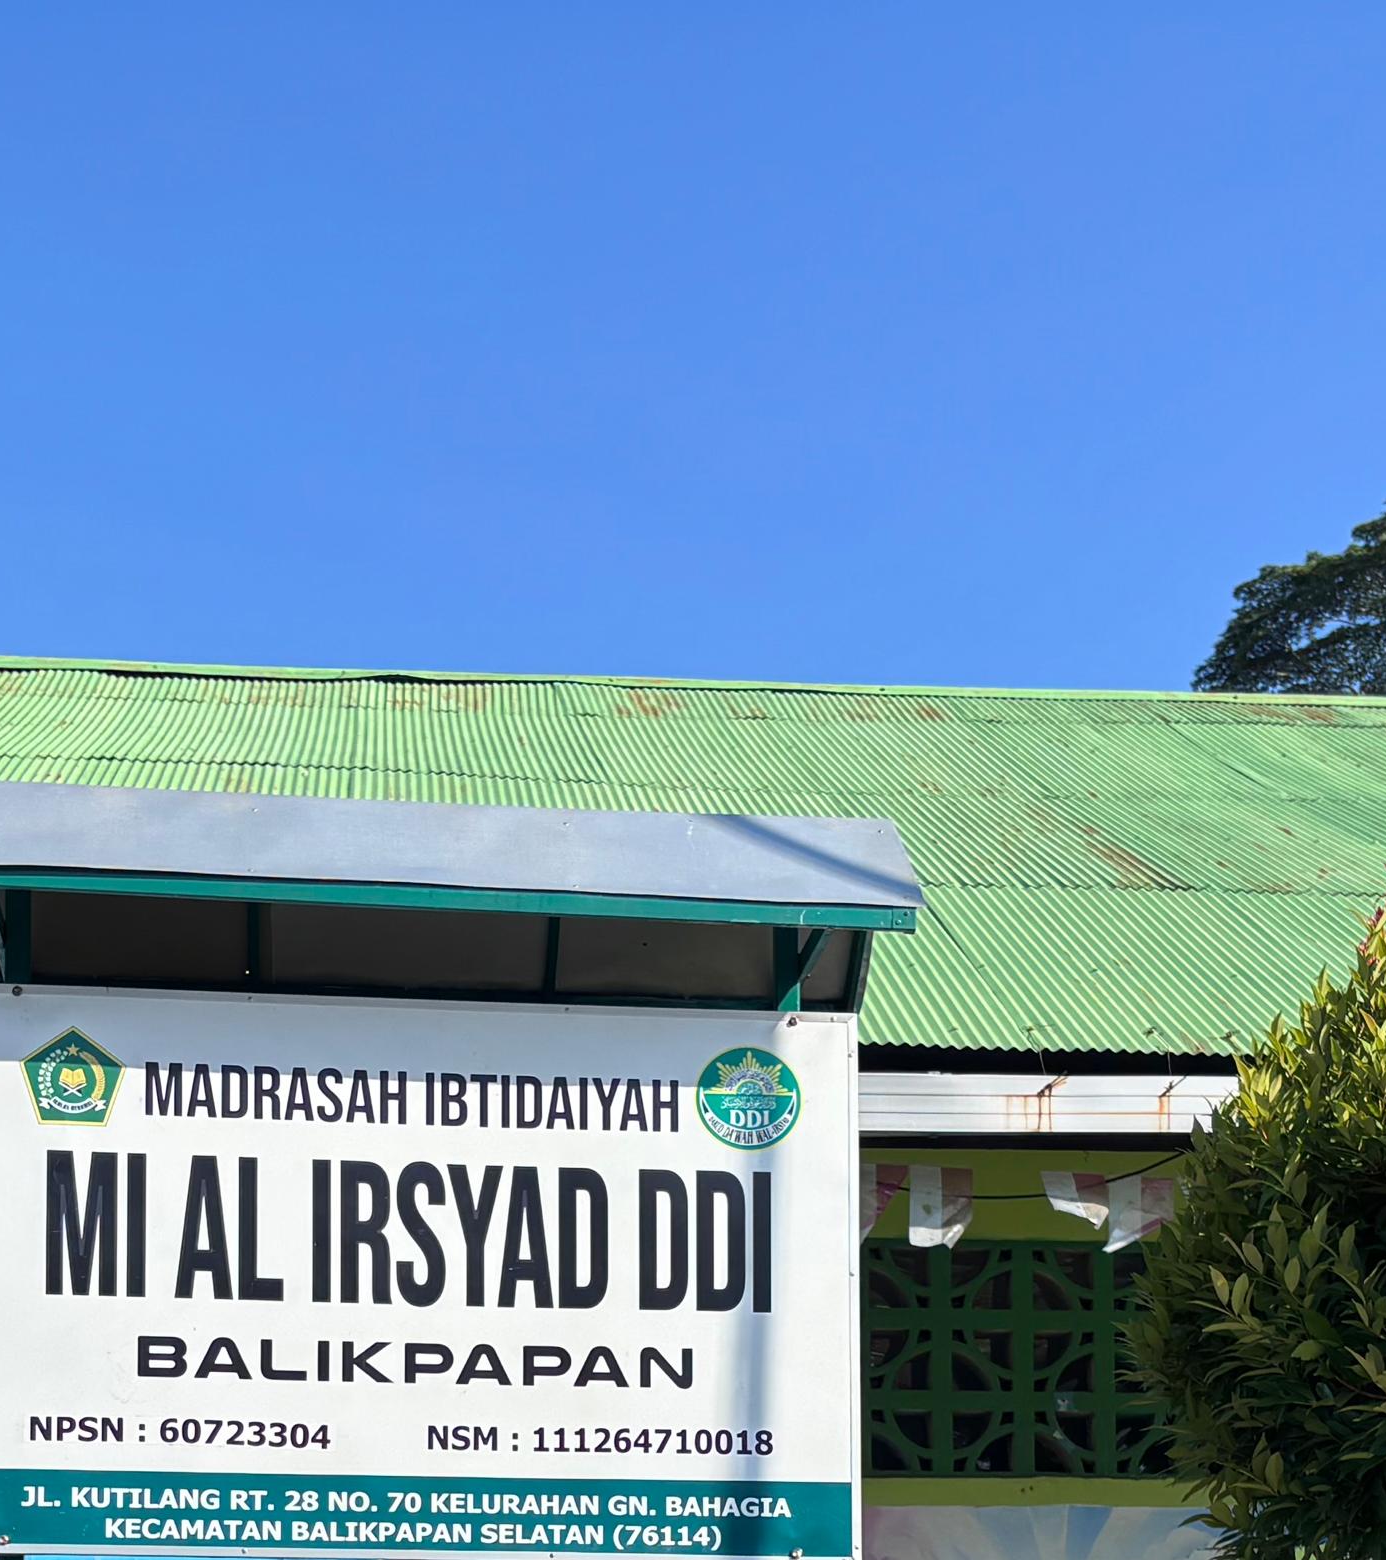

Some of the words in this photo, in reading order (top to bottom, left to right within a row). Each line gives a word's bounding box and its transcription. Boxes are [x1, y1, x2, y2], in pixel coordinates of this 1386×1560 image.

[145, 1061, 407, 1125] MADRASAH
[425, 1072, 679, 1132] IBTIDAIYAH
[729, 1109, 770, 1129] DDI
[45, 1149, 147, 1297] MI
[174, 1155, 284, 1301] AL
[312, 1159, 609, 1309] IRSYAD
[638, 1169, 772, 1313] DDI
[137, 1335, 693, 1390] BALIKPAPAN
[30, 1416, 124, 1442] NPSN
[159, 1418, 331, 1450] 60723304
[427, 1425, 498, 1451] NSM
[533, 1427, 774, 1456] 111264710018
[20, 1486, 61, 1507] JL.
[71, 1486, 220, 1510] KUTILANG
[230, 1489, 275, 1511] RT.
[284, 1490, 319, 1512] 28
[328, 1491, 378, 1512] NO.
[387, 1492, 422, 1513] 70
[431, 1492, 599, 1516] KELURAHAN
[608, 1495, 656, 1517] GN.
[665, 1496, 792, 1519] BAHAGIA
[105, 1518, 282, 1542] KECAMATAN
[291, 1520, 472, 1544] BALIKPAPAN
[480, 1523, 604, 1546] SELATAN
[613, 1524, 722, 1551] (76114)
